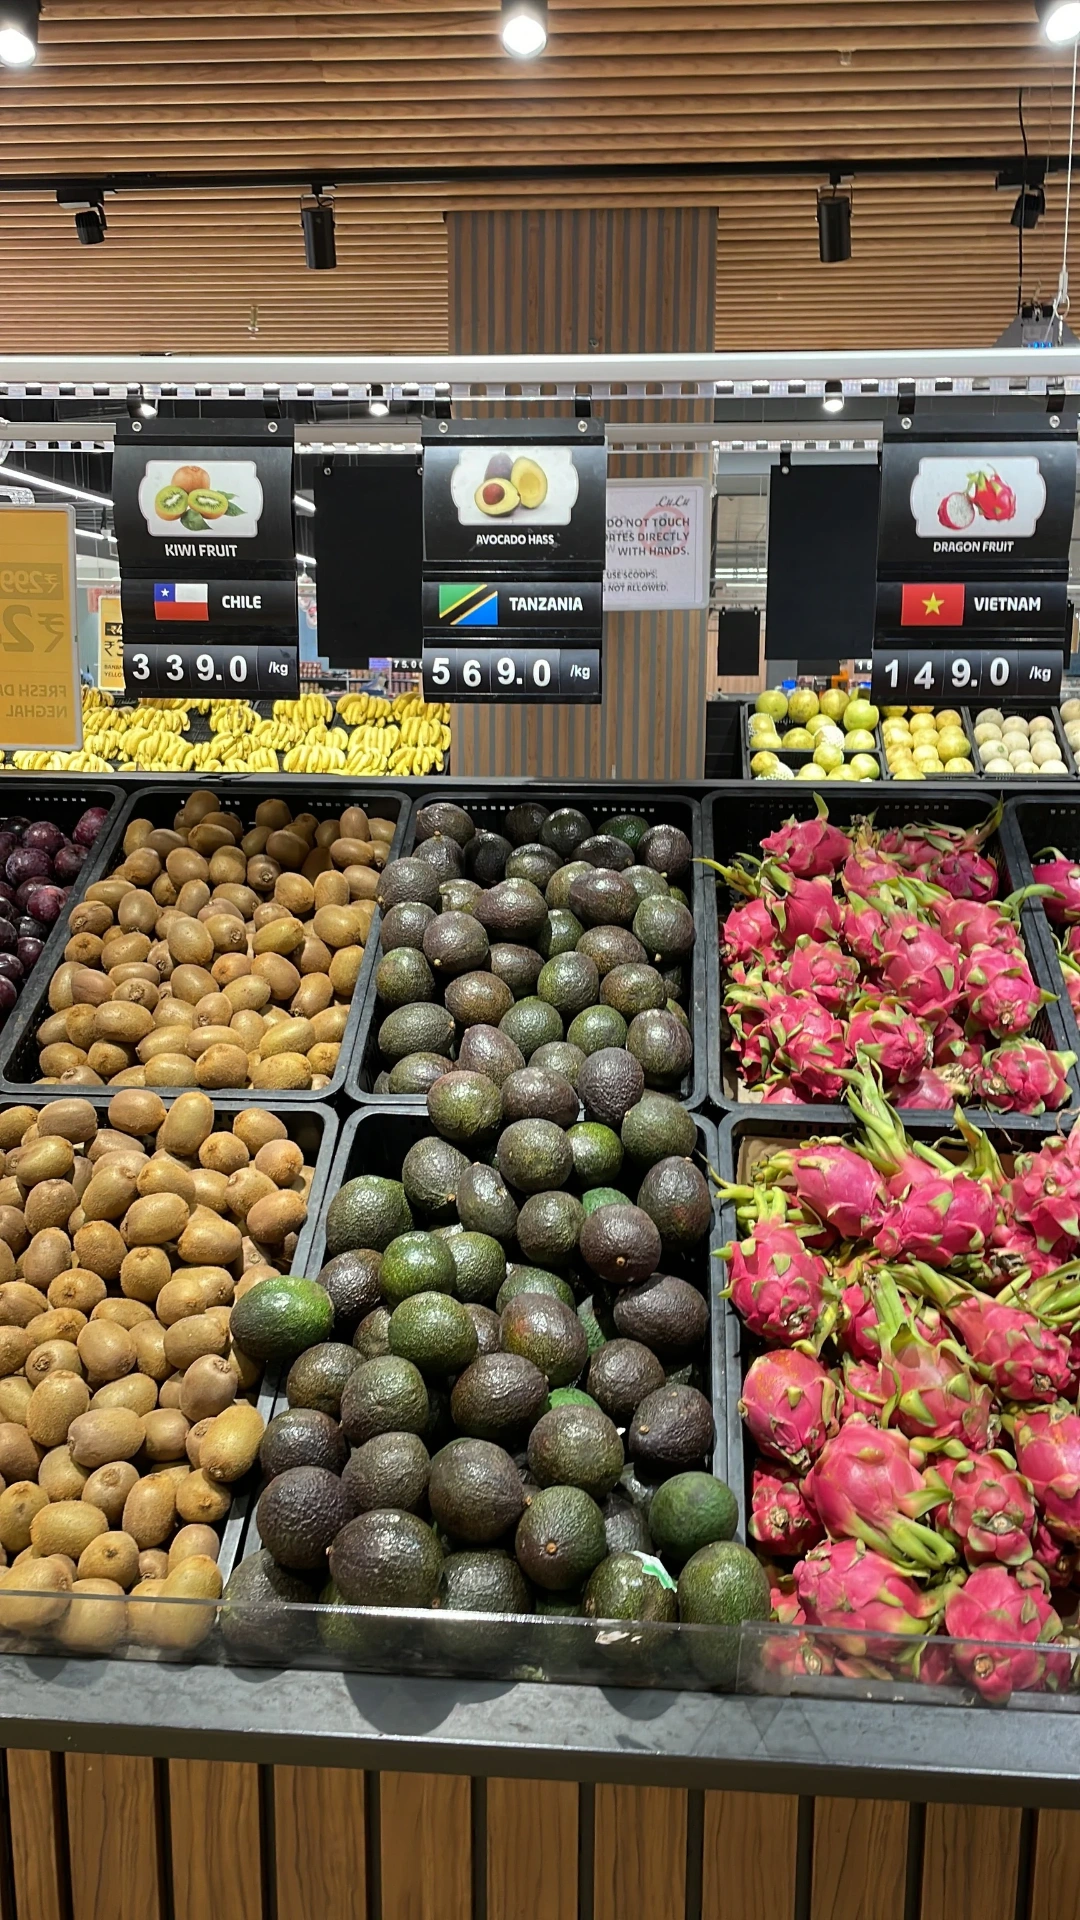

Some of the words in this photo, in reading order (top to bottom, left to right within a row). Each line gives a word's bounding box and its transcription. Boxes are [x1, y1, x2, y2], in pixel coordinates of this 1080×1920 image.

[607, 518, 622, 528] DO
[626, 518, 649, 528] NOT
[652, 517, 690, 527] TOUCH
[476, 534, 526, 545] AVOCADO
[528, 534, 554, 545] HASS
[638, 532, 690, 542] DIRECTLY
[164, 544, 196, 557] KIWI
[199, 544, 238, 558] FRUIT
[618, 546, 646, 556] WITH
[649, 546, 690, 556] HANDS.
[933, 541, 980, 552] DRAGON
[982, 541, 1014, 552] FRUIT
[606, 572, 623, 580] USE
[624, 571, 658, 579] SCOOPS.
[222, 595, 262, 610] CHILE
[509, 596, 584, 612] TANZANIA
[974, 596, 1041, 612] VIETNAM
[268, 661, 288, 676] /kg
[570, 664, 590, 680] /kg
[1029, 666, 1052, 682] /kg
